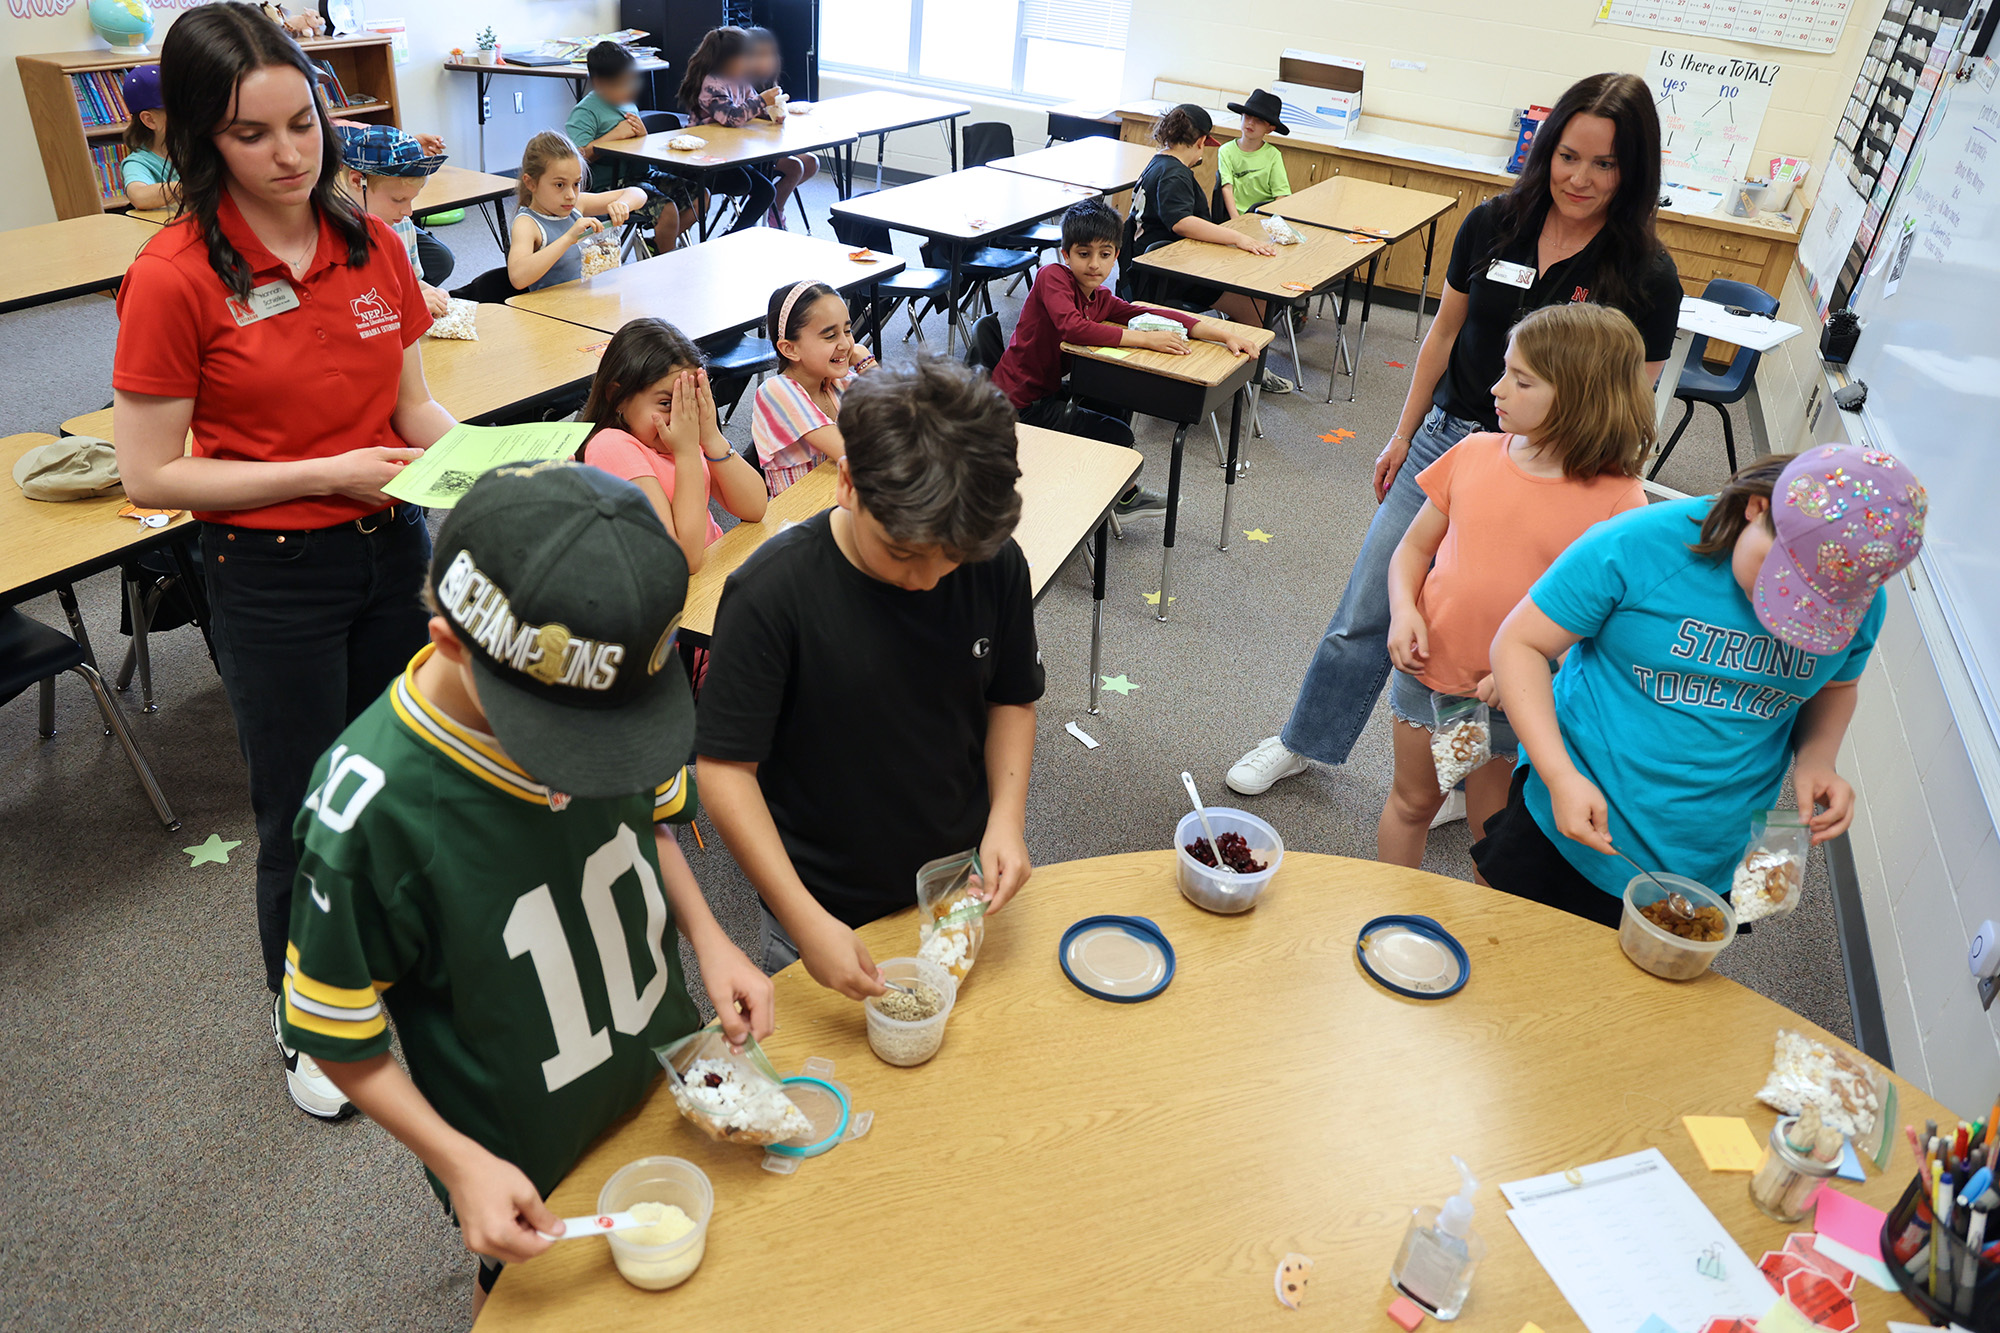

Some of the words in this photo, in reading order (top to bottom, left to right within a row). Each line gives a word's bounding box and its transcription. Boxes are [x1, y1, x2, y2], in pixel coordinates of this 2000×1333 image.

[1680, 54, 1715, 75] there
[1718, 65, 1727, 75] a
[1660, 77, 1688, 98] yes
[1719, 84, 1739, 98] no
[1571, 286, 1589, 302] N
[361, 309, 380, 322] NEP
[450, 568, 625, 691] CHAMPONS
[1670, 618, 1817, 680] STRONG
[1632, 664, 1806, 720] TOGETHE
[502, 821, 668, 1093] 10
